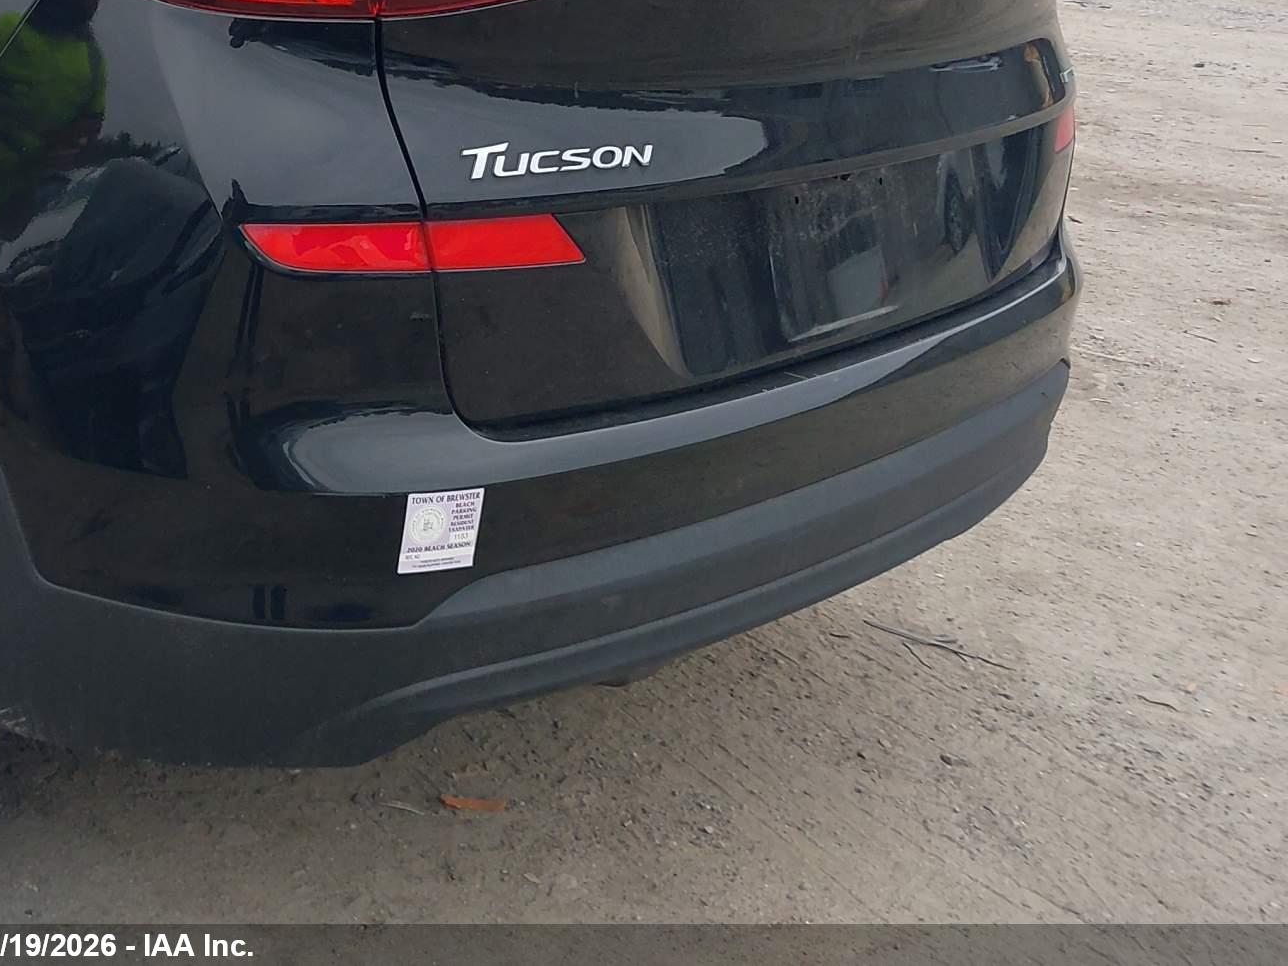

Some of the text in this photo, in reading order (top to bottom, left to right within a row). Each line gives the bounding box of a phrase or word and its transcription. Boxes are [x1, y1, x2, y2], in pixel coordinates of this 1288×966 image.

[412, 492, 480, 505] TOWN OF BREWSTER
[447, 541, 471, 549] SEASON
